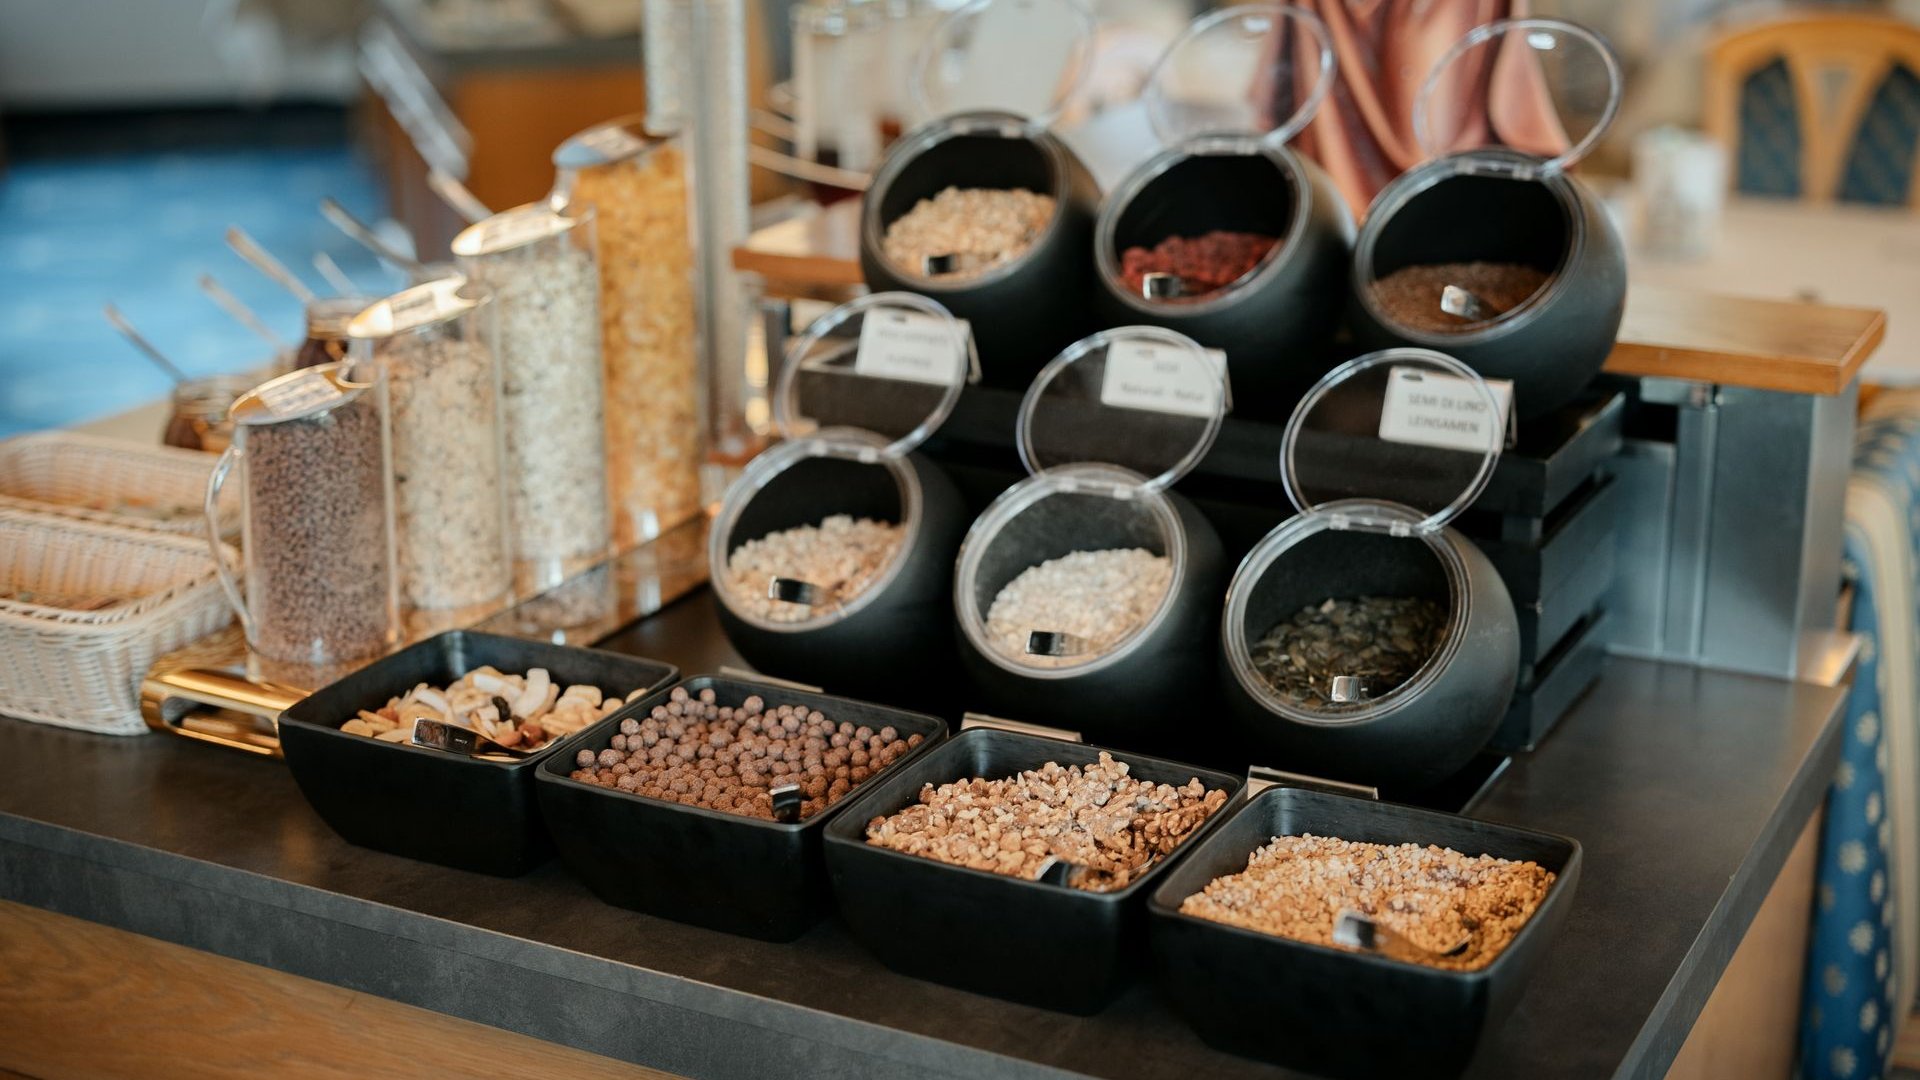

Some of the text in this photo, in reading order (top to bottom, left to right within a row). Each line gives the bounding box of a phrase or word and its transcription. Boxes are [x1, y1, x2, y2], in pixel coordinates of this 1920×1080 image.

[1408, 392, 1438, 406] SEMI
[1441, 396, 1453, 409] DI
[1408, 415, 1480, 433] LEINSAMEN
